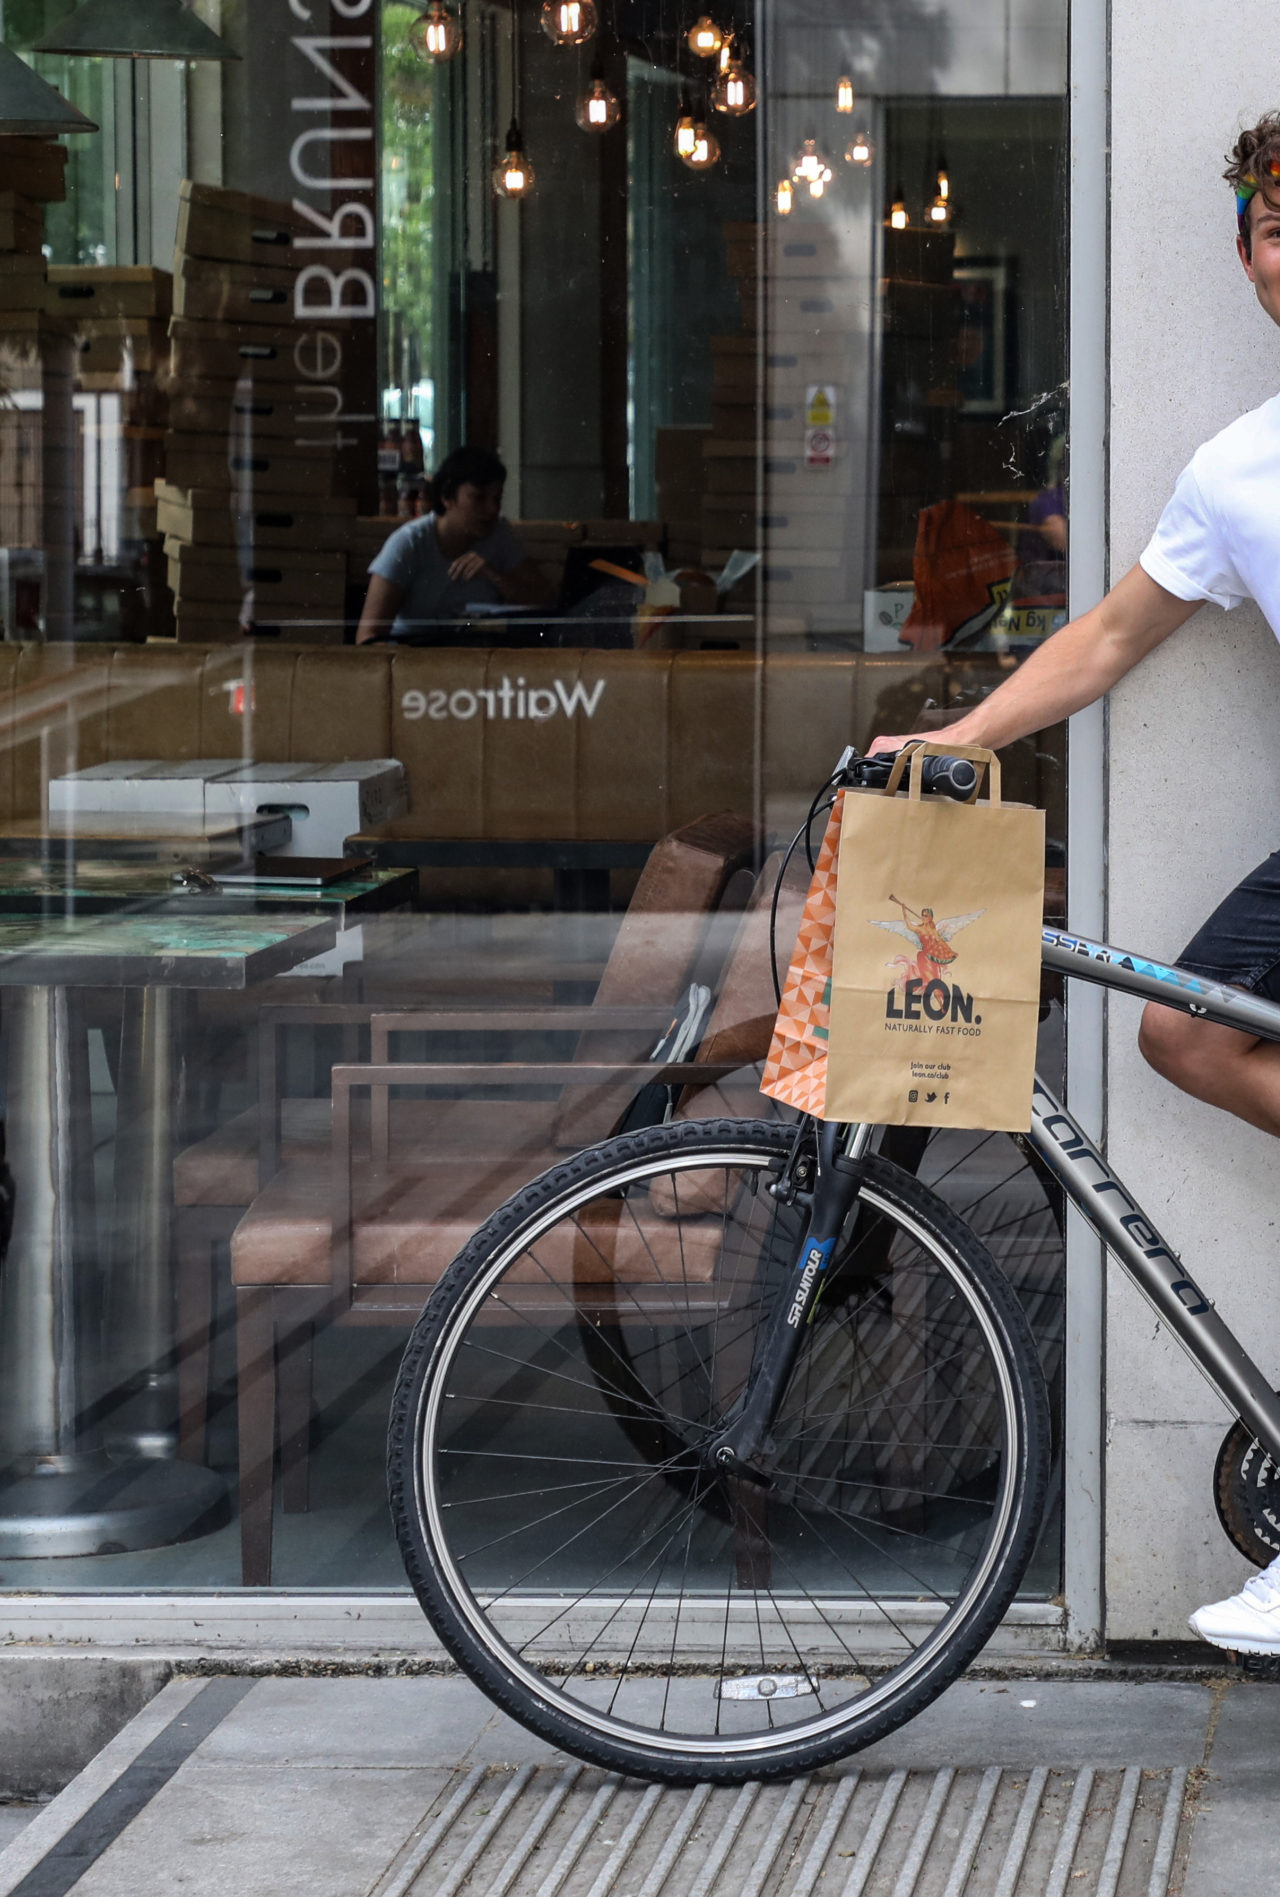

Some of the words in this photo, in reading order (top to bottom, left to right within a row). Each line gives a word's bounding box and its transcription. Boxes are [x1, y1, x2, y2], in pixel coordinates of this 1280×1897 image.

[886, 978, 982, 1025] LEON.
[884, 1023, 933, 1034] NATURALLY
[936, 1026, 955, 1035] FAST
[957, 1027, 982, 1037] FOOD
[910, 1061, 923, 1070] Join
[937, 1063, 951, 1071] club
[912, 1071, 950, 1080] leon.co/club
[795, 1248, 822, 1306] SUNTOUR
[787, 1302, 804, 1329] SR
